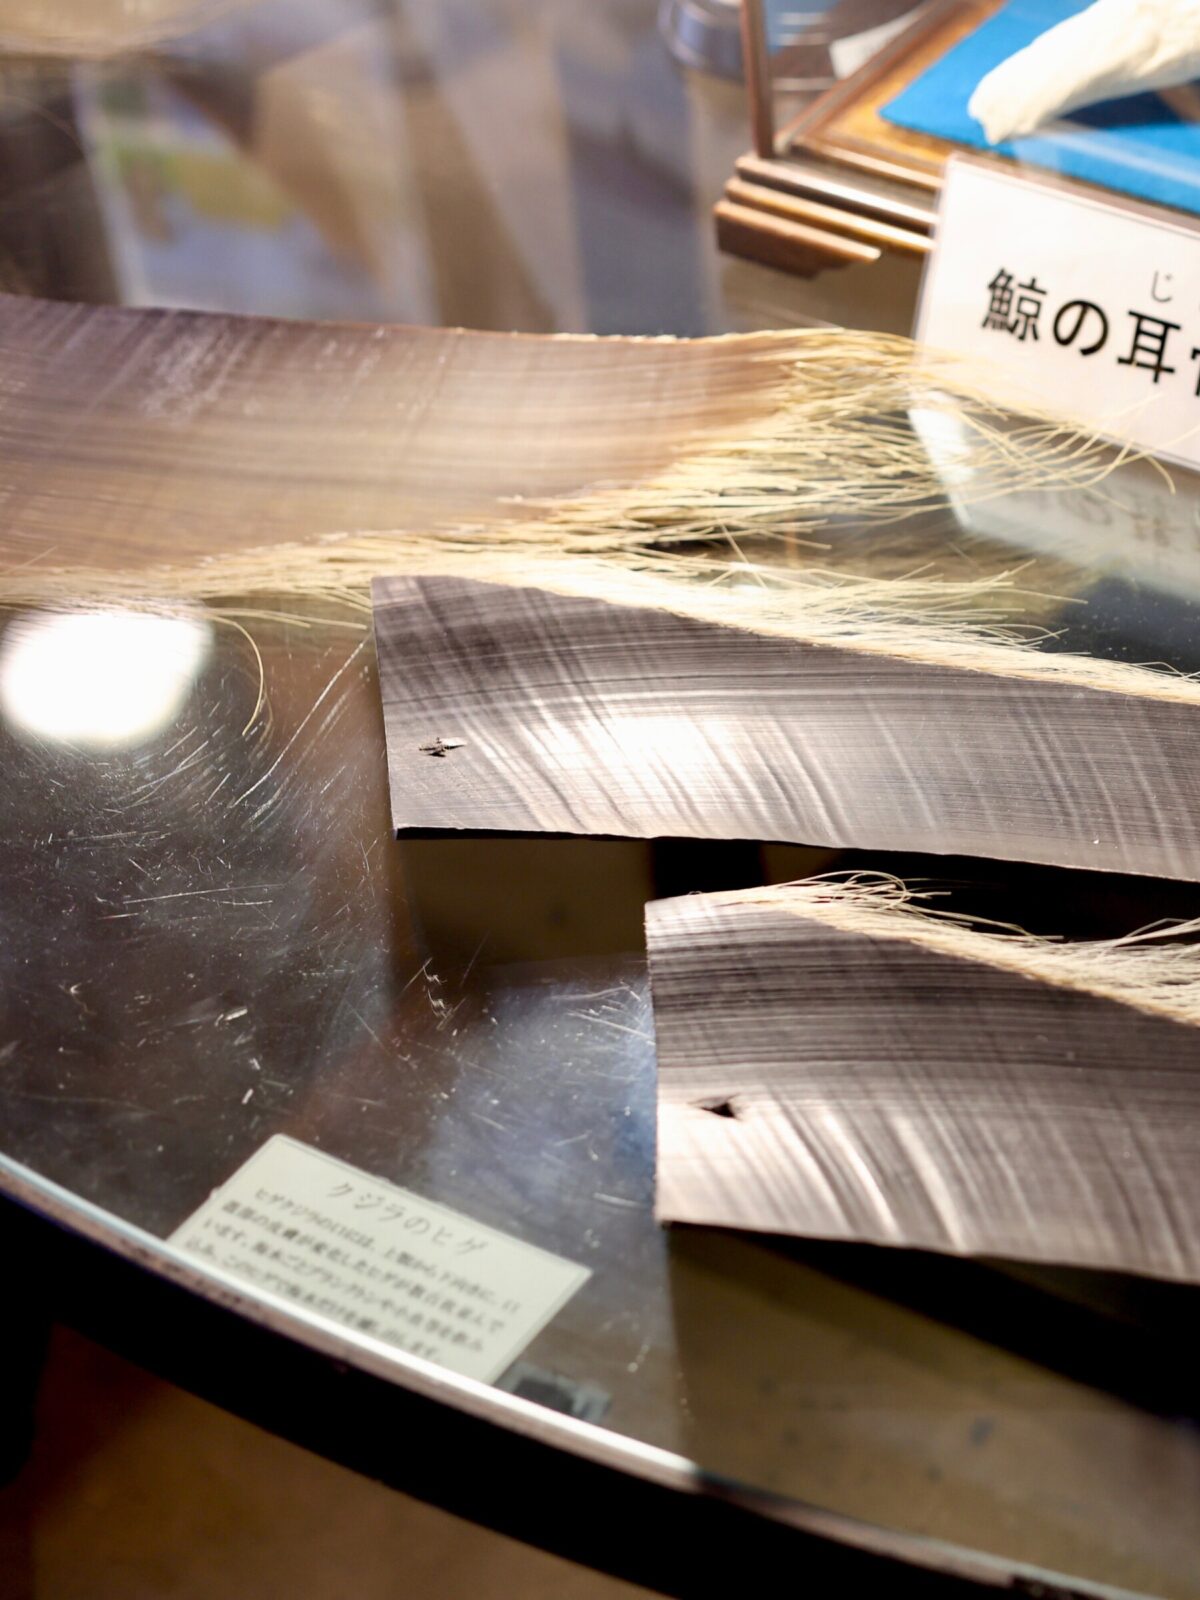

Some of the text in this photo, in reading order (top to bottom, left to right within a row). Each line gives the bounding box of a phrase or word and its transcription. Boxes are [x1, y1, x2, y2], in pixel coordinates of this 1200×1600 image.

[1151, 270, 1173, 303] じ
[325, 1180, 488, 1257] クジラのヒゲ
